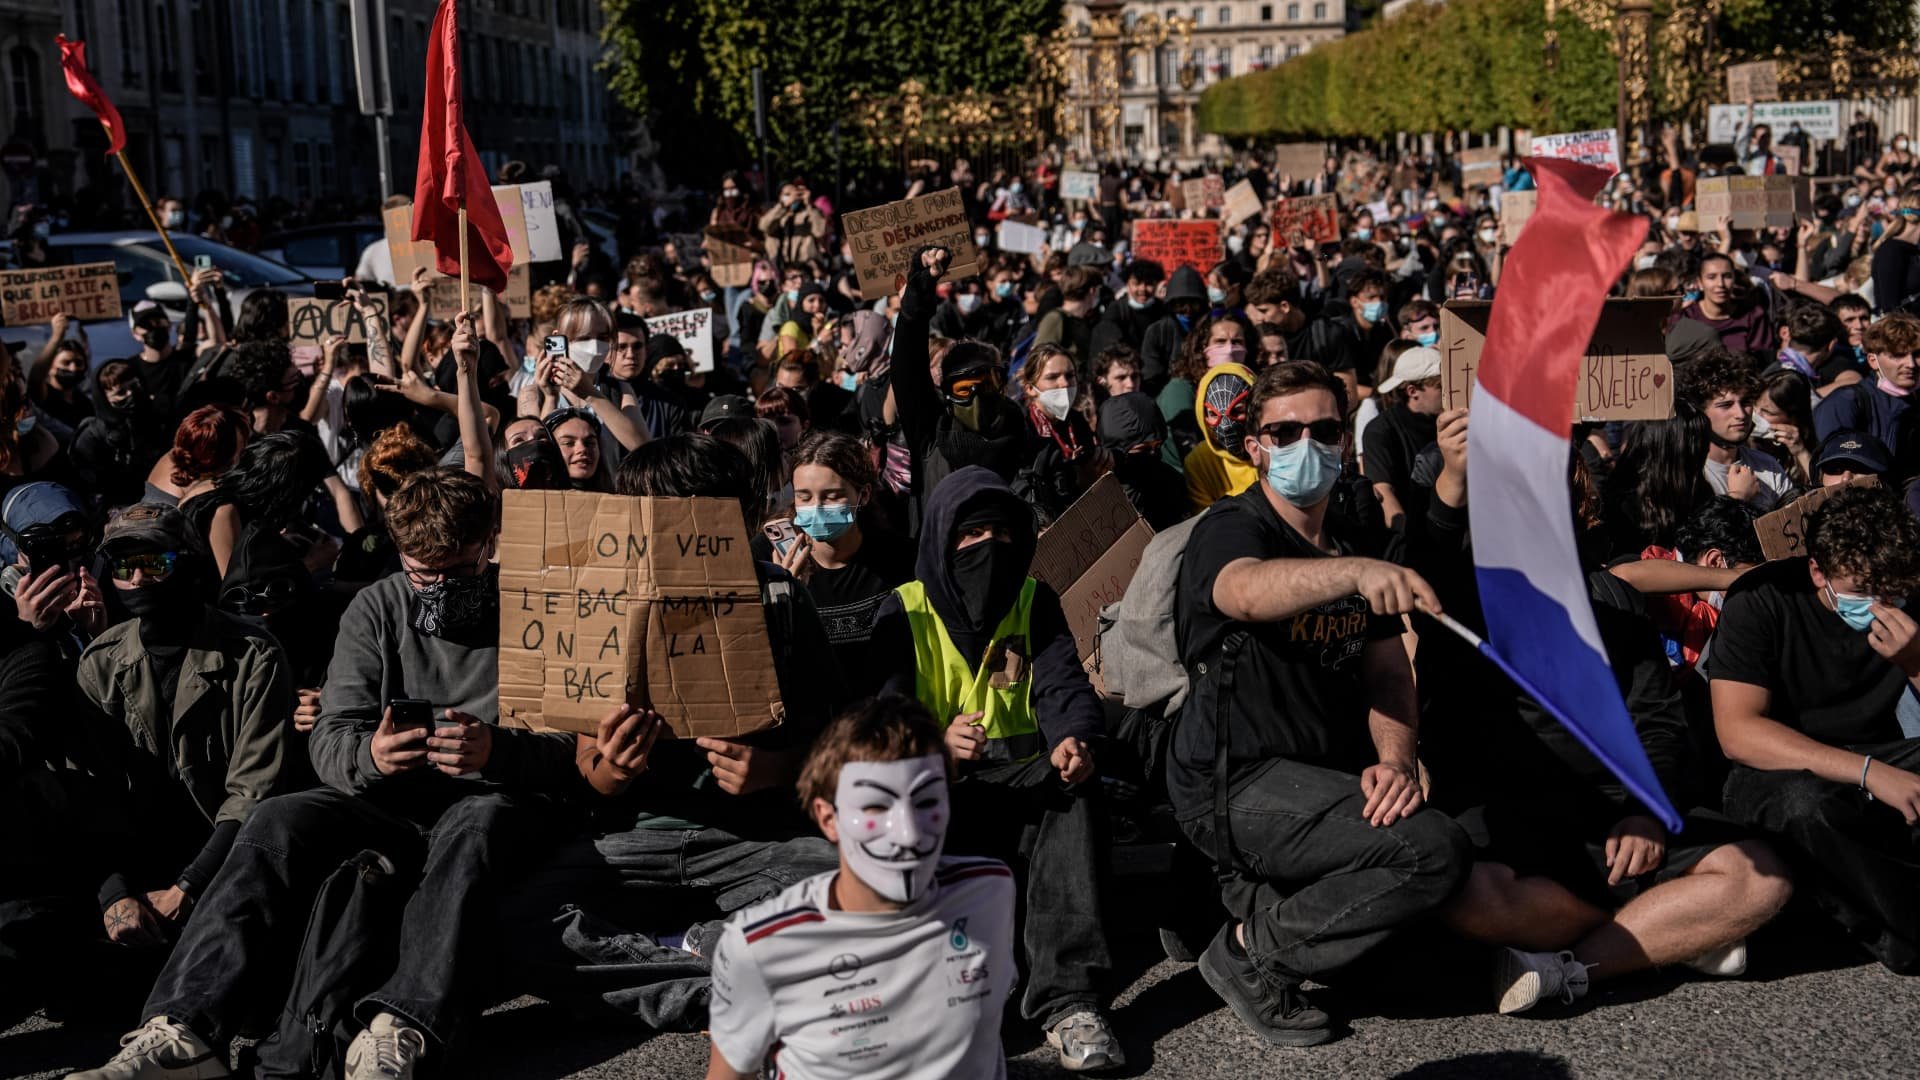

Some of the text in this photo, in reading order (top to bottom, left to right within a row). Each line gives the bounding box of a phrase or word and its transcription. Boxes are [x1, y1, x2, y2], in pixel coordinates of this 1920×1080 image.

[854, 233, 878, 253] LE
[3, 287, 33, 303] QUE
[41, 284, 59, 298] LA
[64, 280, 97, 296] BITE
[18, 296, 106, 320] BRIGITTE
[597, 532, 735, 560] ON VEUT
[521, 587, 560, 615] LE
[577, 588, 627, 618] BAC
[522, 620, 706, 660] ON A LA
[564, 667, 613, 703] BAC
[849, 994, 883, 1015] UBS
